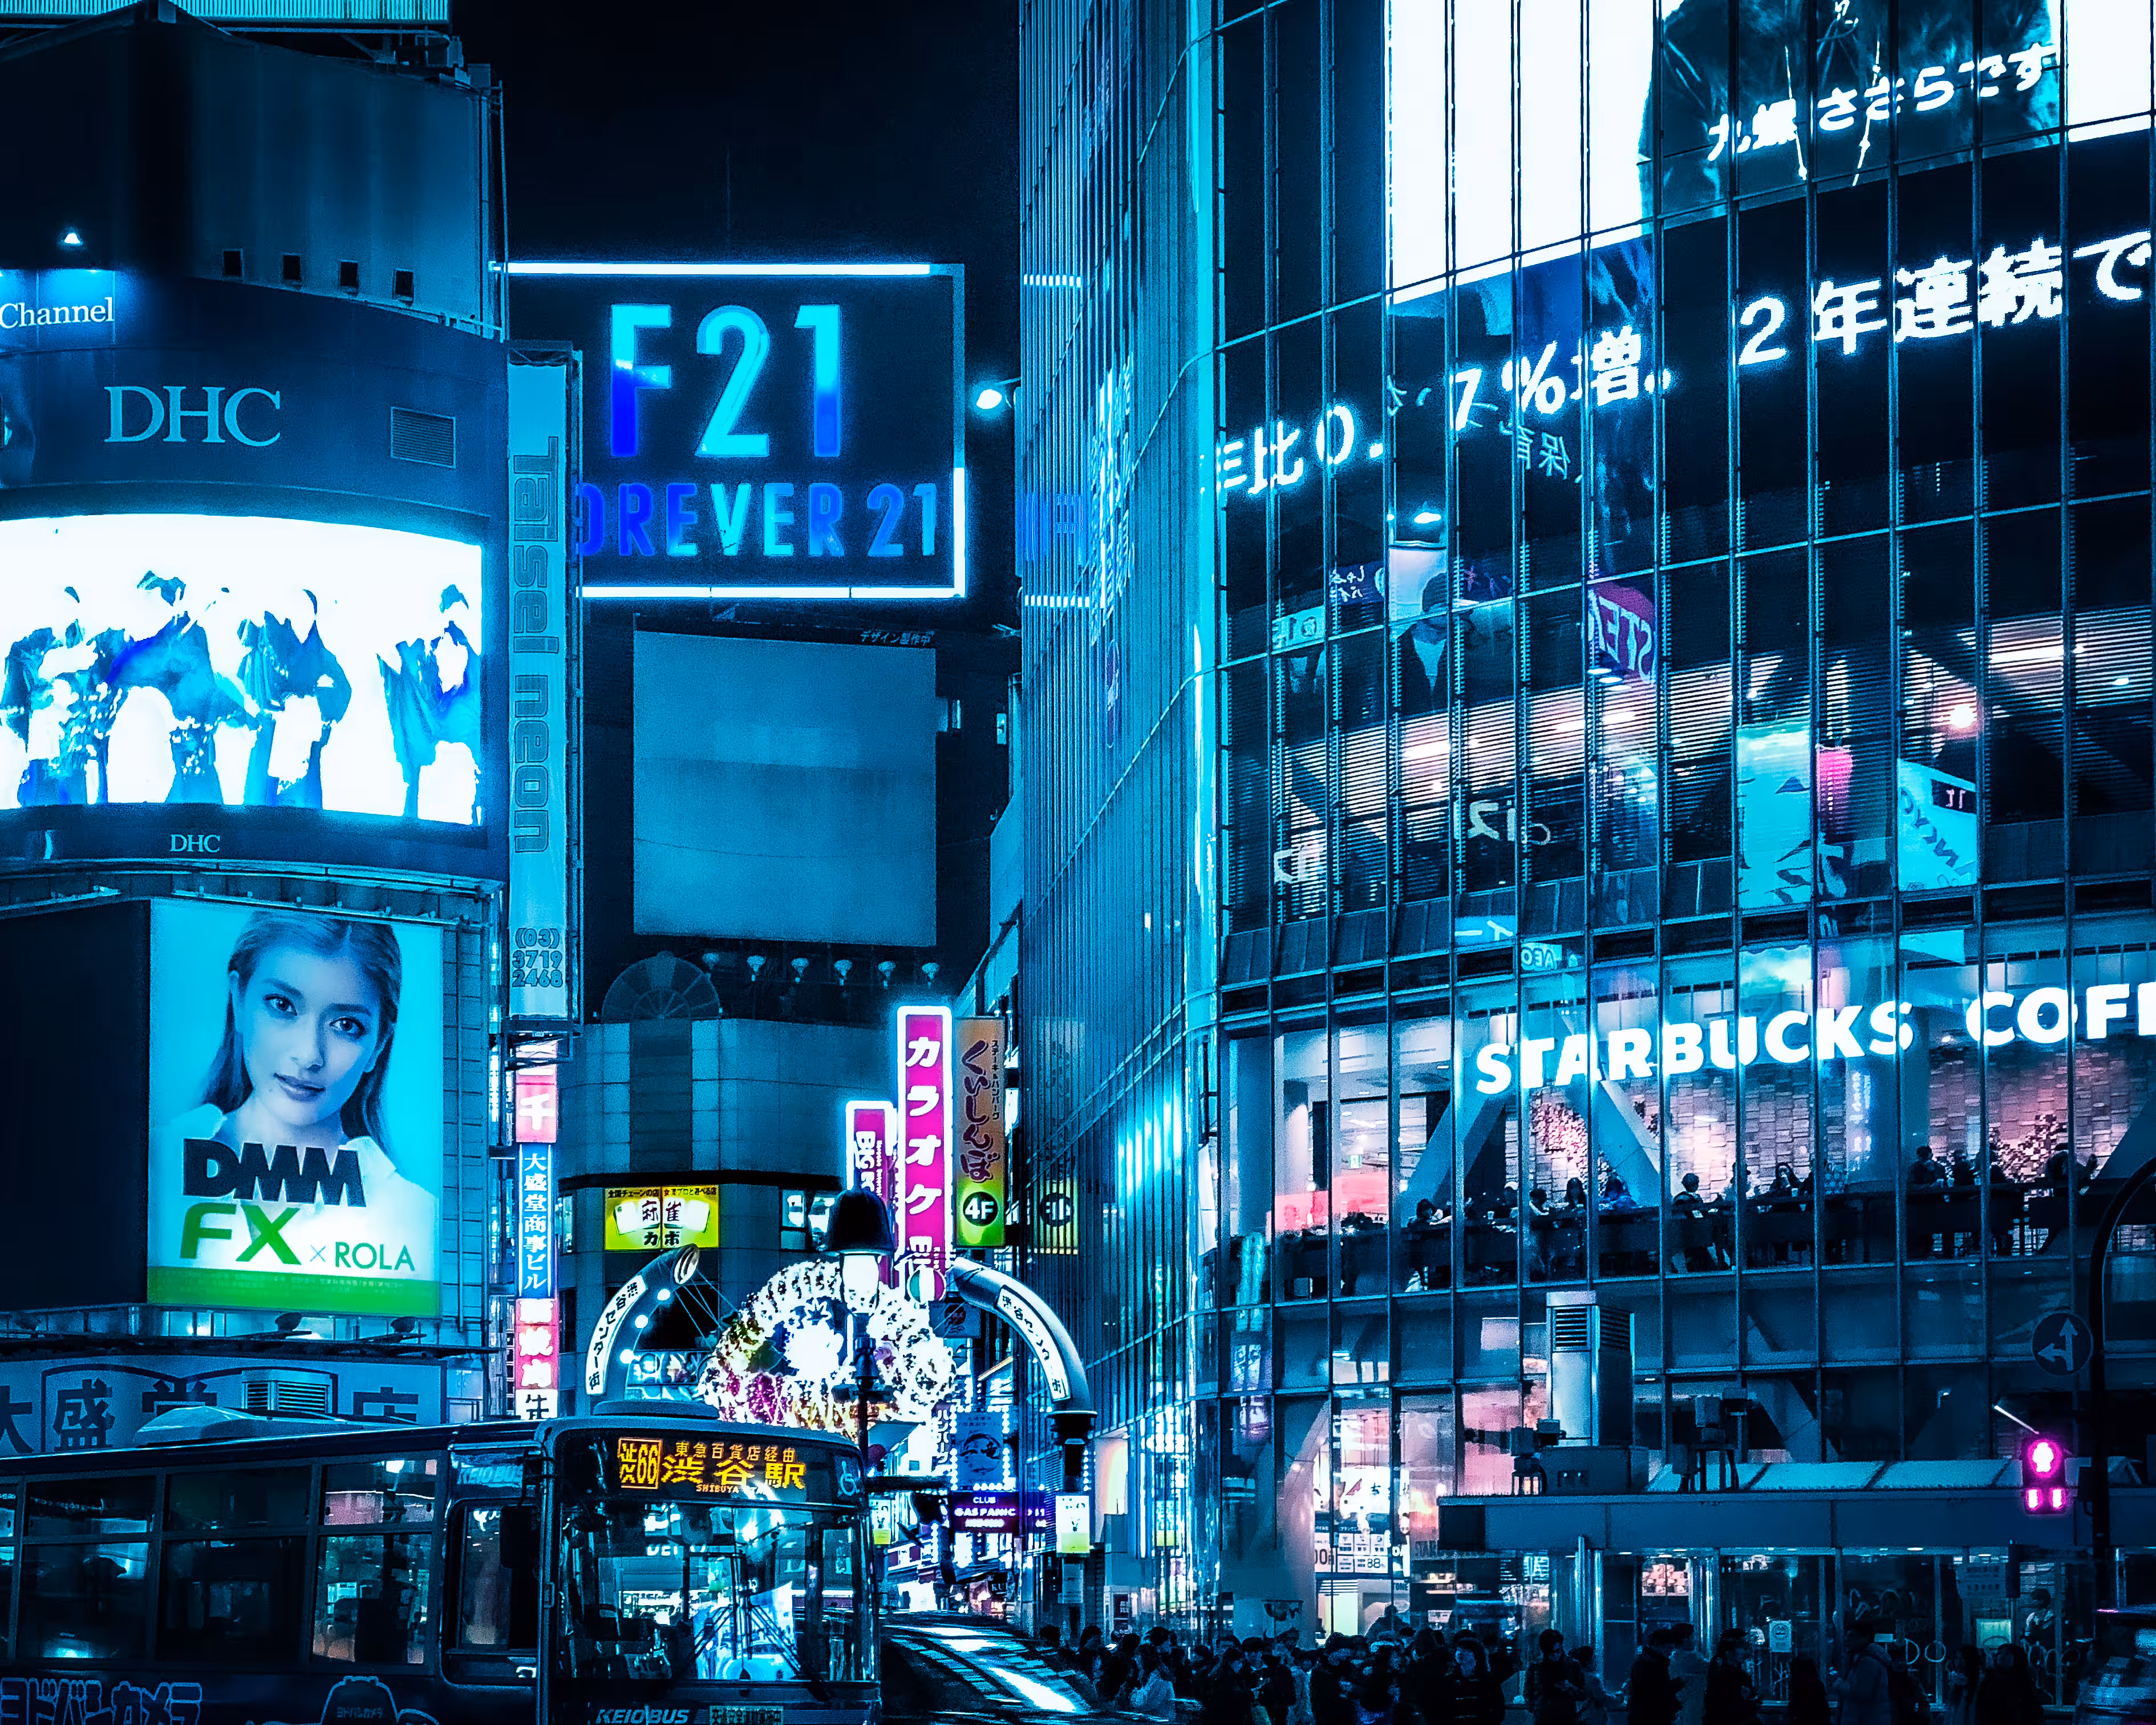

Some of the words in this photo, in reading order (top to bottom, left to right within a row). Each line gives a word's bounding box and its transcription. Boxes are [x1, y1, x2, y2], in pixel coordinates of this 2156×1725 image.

[0, 297, 115, 329] Channel
[104, 385, 281, 447] DHC
[866, 483, 937, 557] 21
[515, 674, 550, 854] neon
[169, 833, 221, 854] DHC
[515, 928, 560, 949] (03)
[512, 950, 563, 969] 3719
[512, 969, 564, 988] 2468
[1476, 999, 1912, 1095] STARBUCKS
[905, 1036, 942, 1215] カラオケ
[182, 1137, 367, 1208] DMM
[524, 1153, 548, 1290] 大盛堂商事ビル
[964, 1198, 995, 1220] 4F
[179, 1201, 302, 1266] FX
[334, 1241, 416, 1272] ROLA
[674, 1441, 796, 1463] 東急百貨店経由
[660, 1455, 806, 1490] 渋谷駅
[595, 1708, 646, 1724] KEIO
[648, 1708, 690, 1724] BUS
